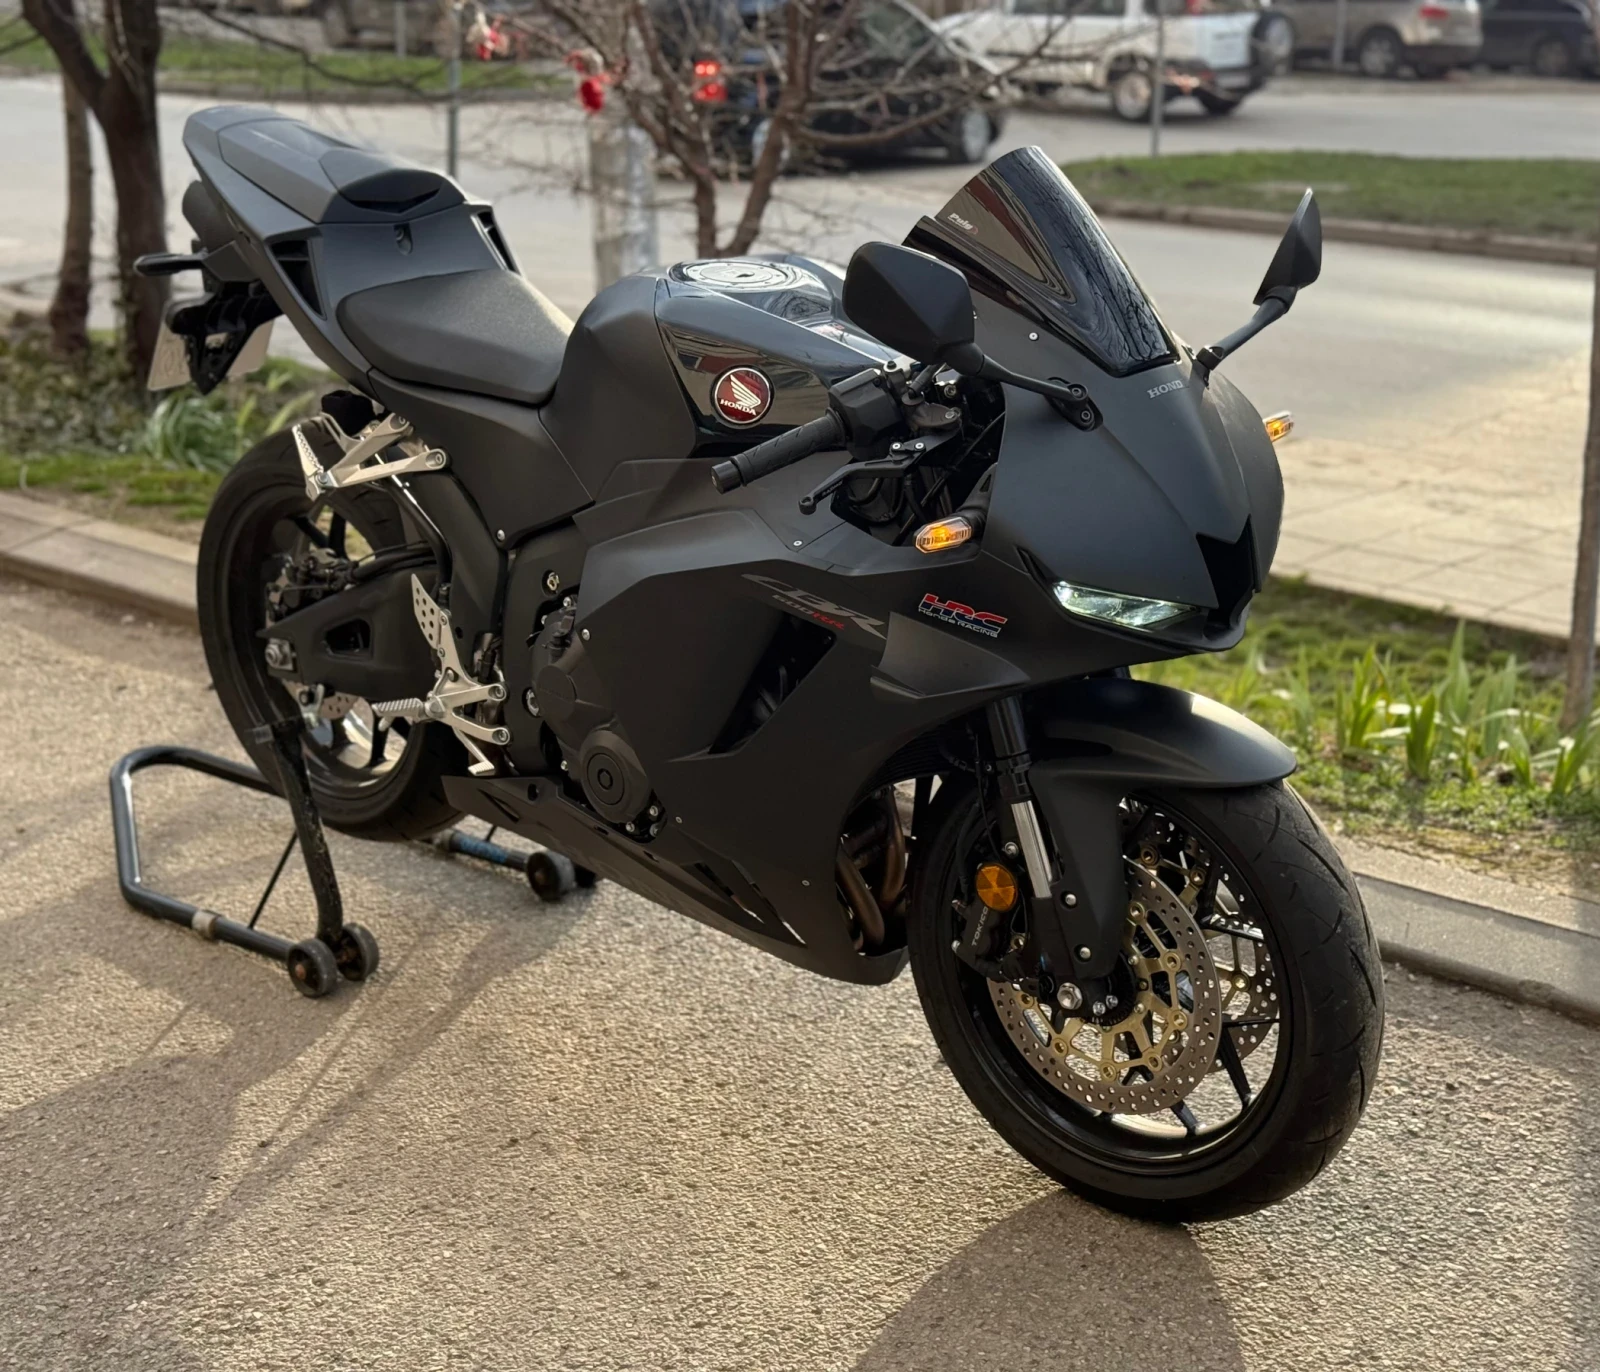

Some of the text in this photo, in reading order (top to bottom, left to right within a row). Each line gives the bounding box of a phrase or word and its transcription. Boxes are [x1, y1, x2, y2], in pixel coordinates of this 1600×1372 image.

[720, 398, 757, 416] HONDA
[1146, 379, 1184, 399] HOND
[741, 573, 888, 641] CBR
[918, 608, 998, 638] Honda RACING
[919, 593, 1008, 635] HRC
[971, 905, 989, 947] TOKICO
